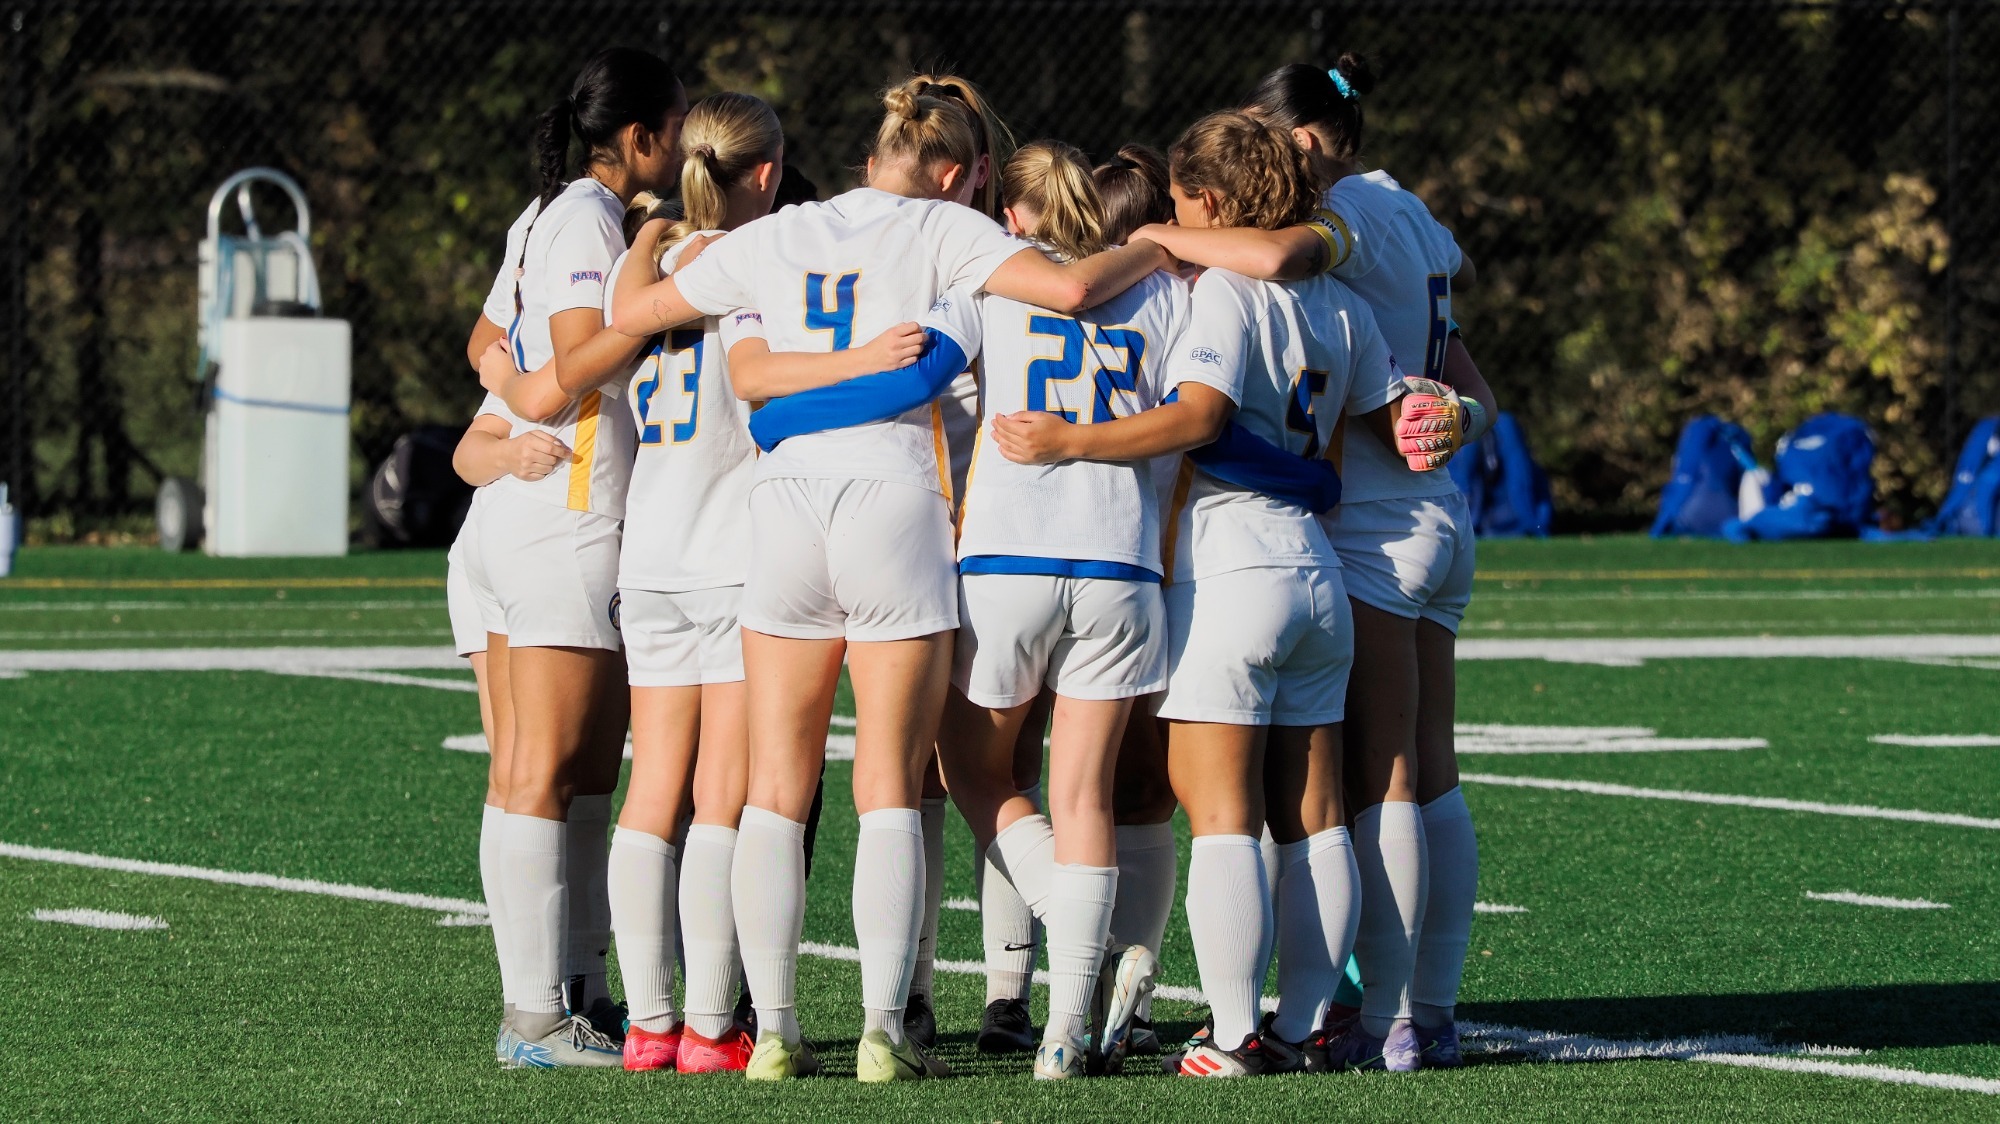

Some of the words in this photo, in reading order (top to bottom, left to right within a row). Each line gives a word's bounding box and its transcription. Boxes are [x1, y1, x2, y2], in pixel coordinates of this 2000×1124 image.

[572, 271, 602, 283] NAIA
[802, 268, 862, 352] 4
[1024, 311, 1148, 424] 22
[1191, 350, 1220, 363] GPAC
[1423, 273, 1448, 382] 6
[634, 325, 704, 446] 23
